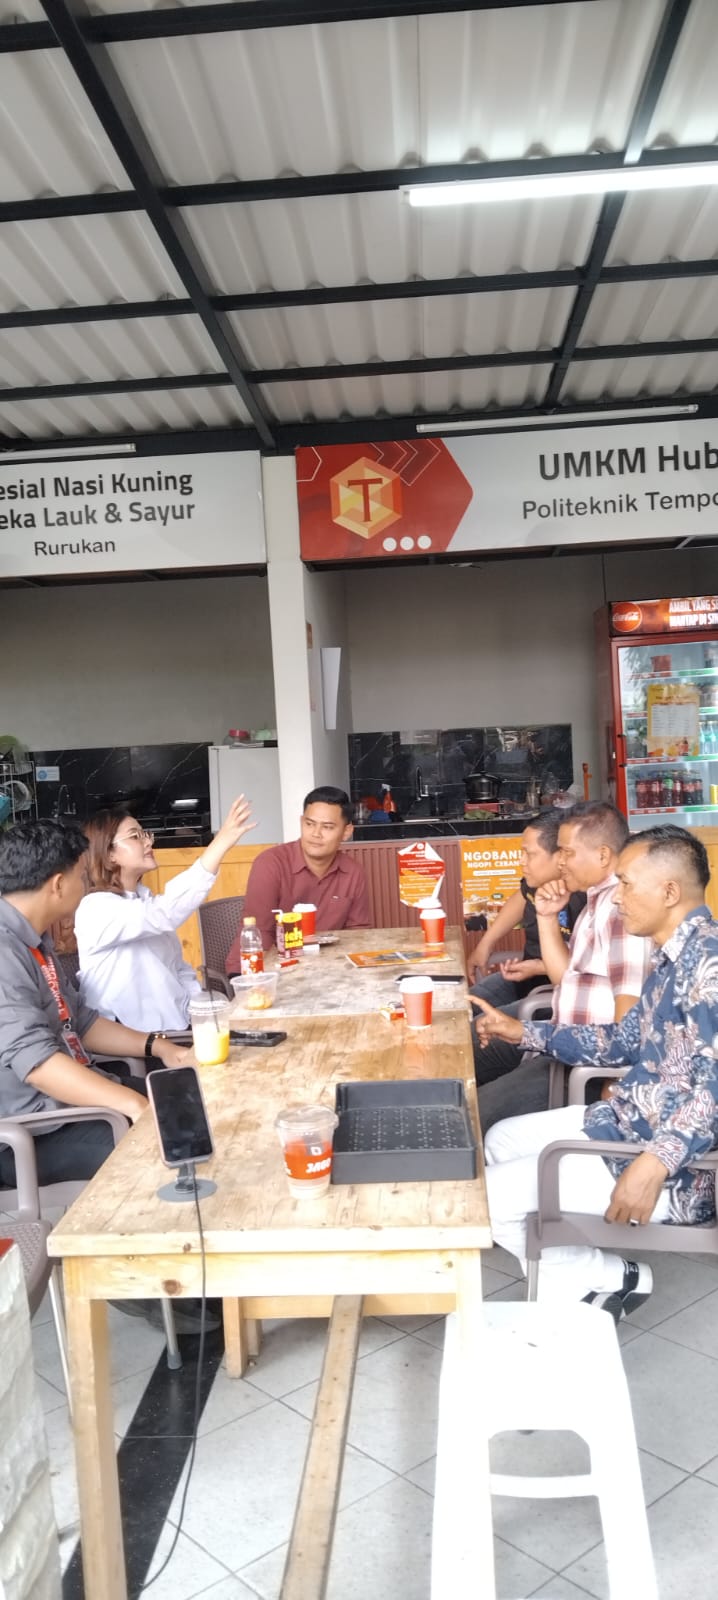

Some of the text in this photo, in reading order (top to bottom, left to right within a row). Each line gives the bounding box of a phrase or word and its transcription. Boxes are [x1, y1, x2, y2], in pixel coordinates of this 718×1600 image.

[538, 441, 718, 481] UMKM Hub
[54, 473, 104, 497] Nasi
[111, 470, 194, 495] Kuning
[347, 477, 384, 523] T
[522, 492, 639, 520] Politeknik
[0, 501, 196, 529] eka Lauk & Sayur
[34, 539, 116, 556] Rurukan
[691, 598, 711, 611] YANG
